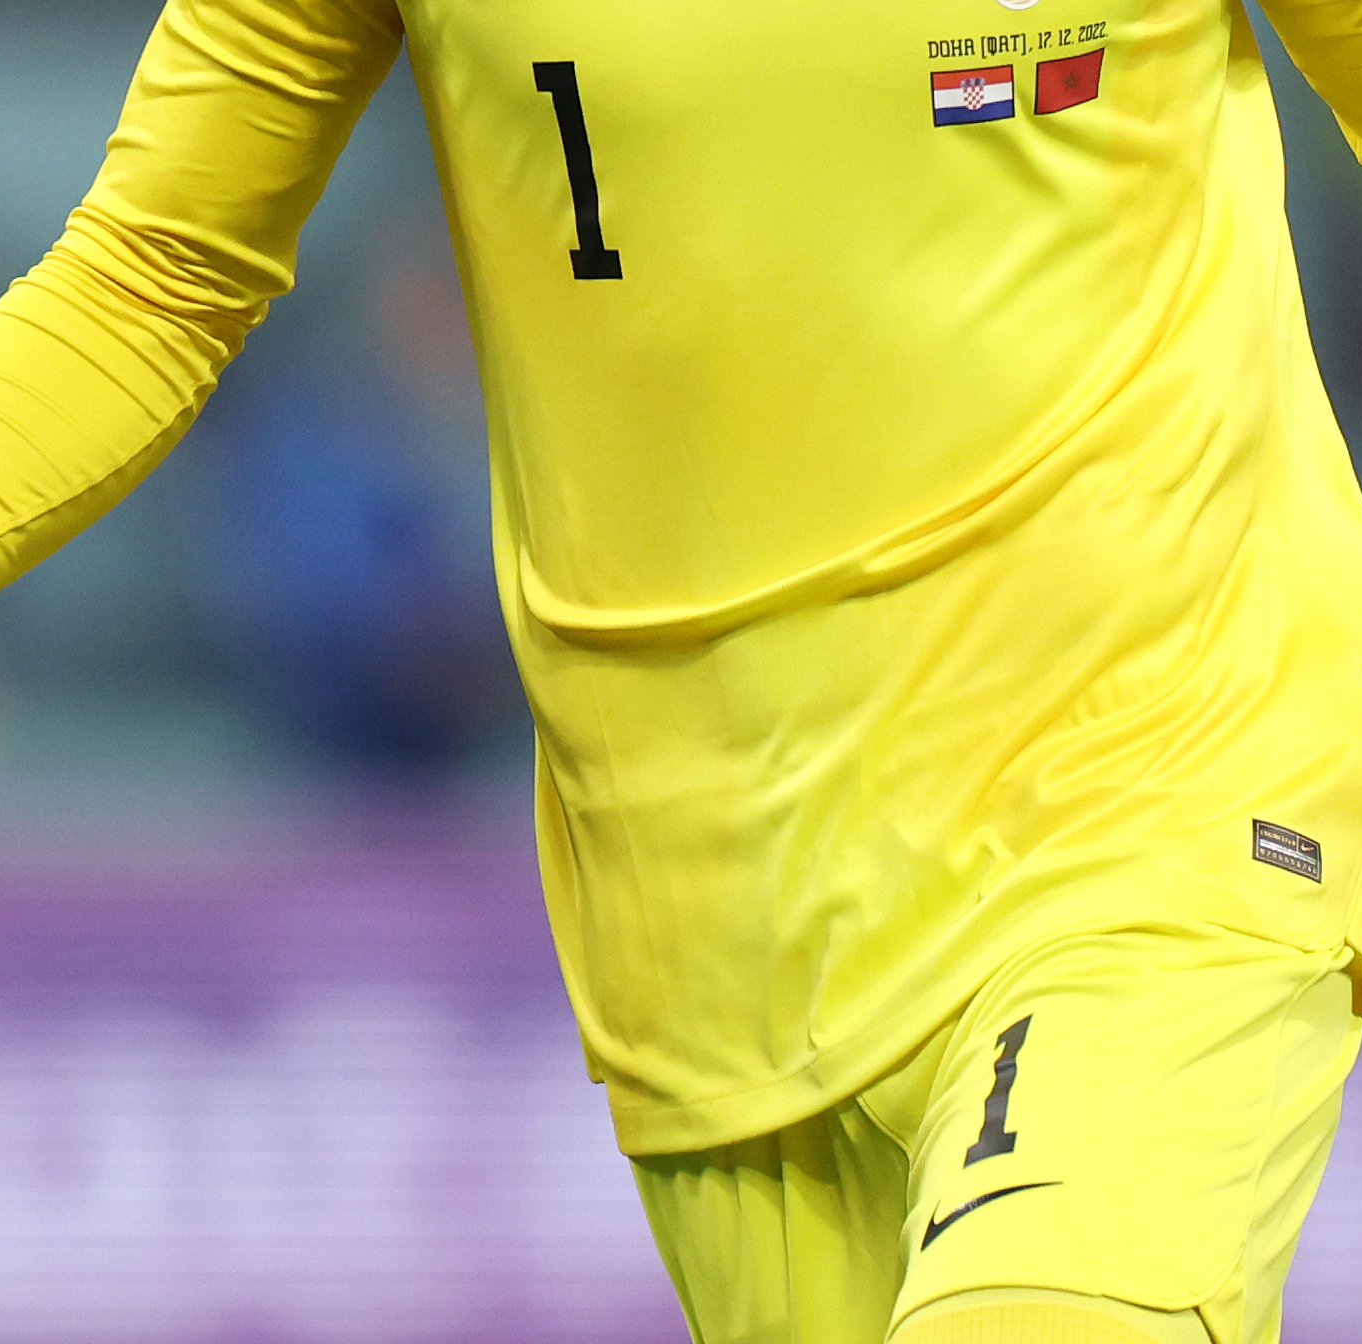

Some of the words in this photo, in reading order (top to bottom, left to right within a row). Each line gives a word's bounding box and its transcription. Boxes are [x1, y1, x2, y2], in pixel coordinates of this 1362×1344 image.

[927, 38, 975, 59] DOHA
[1038, 31, 1053, 50] 17.
[1058, 28, 1074, 47] 12.
[532, 61, 623, 280] 1
[963, 1013, 1034, 1169] 1
